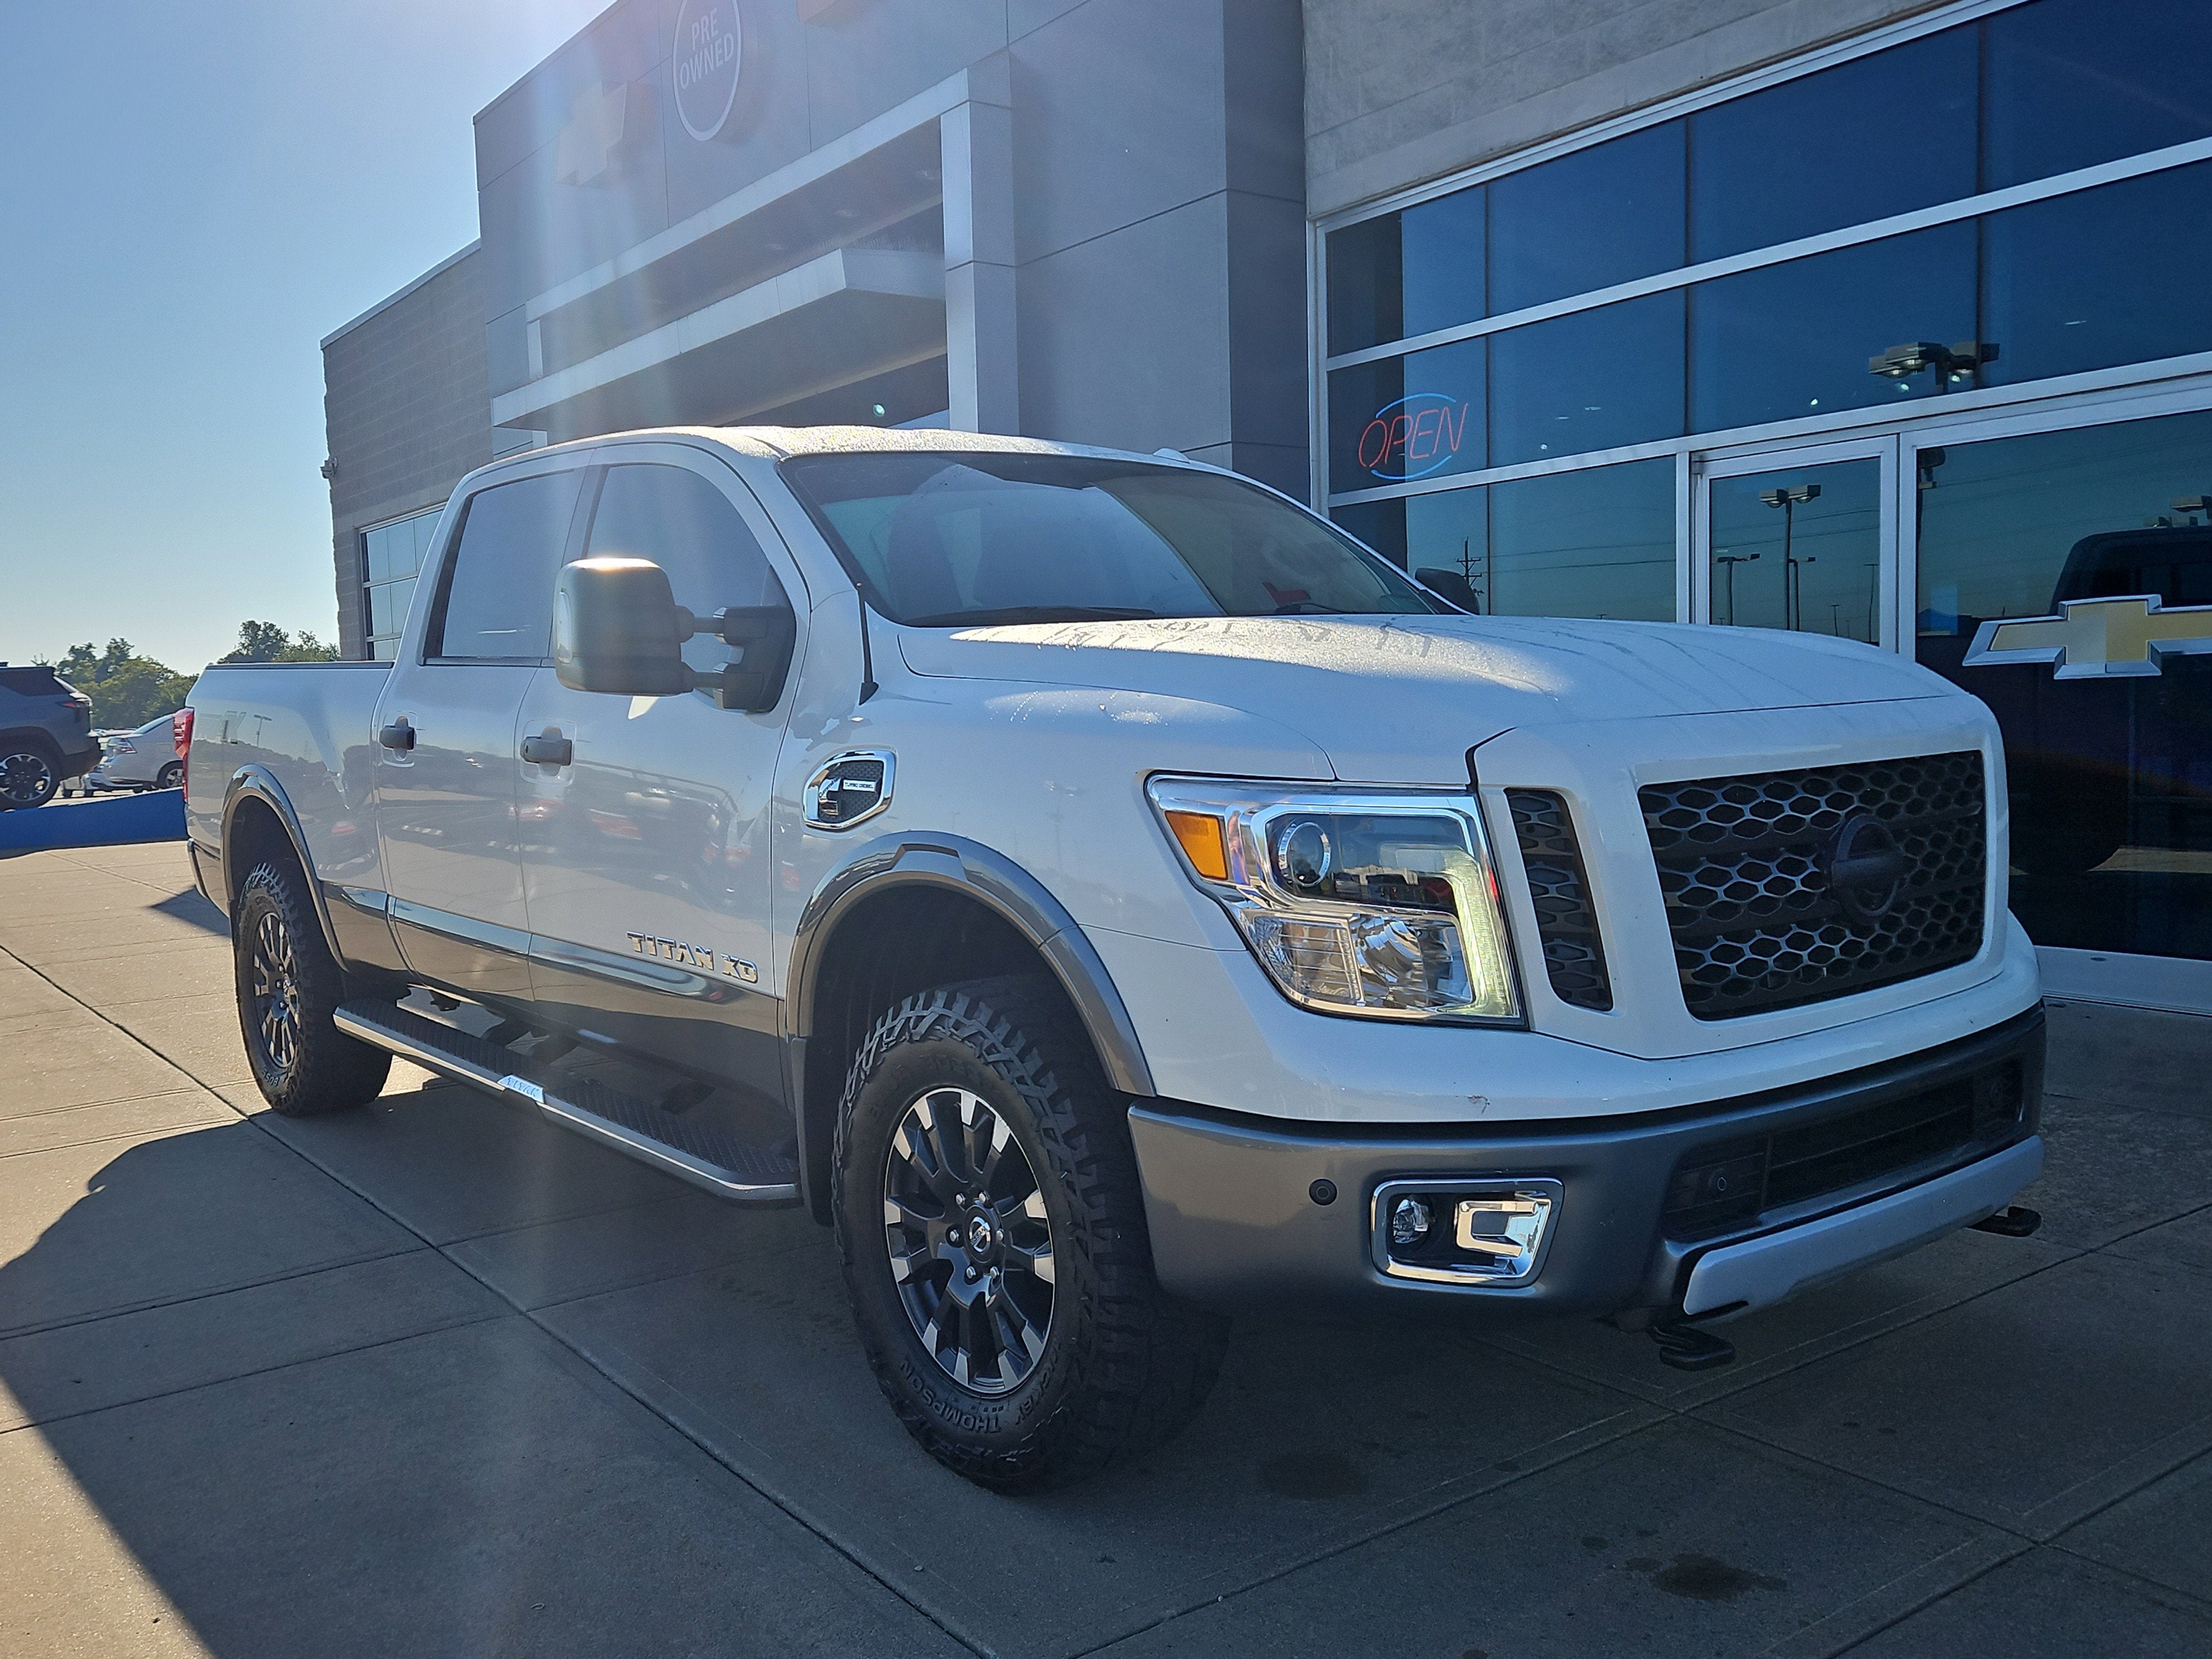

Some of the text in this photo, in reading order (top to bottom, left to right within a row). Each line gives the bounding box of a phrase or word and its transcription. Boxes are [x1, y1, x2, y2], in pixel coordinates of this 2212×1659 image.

[691, 8, 718, 50] PRE
[679, 33, 734, 90] OWNED
[1358, 402, 1469, 468] OPEN
[627, 930, 758, 984] TITAN XD
[900, 1361, 1002, 1433] THOMPSON
